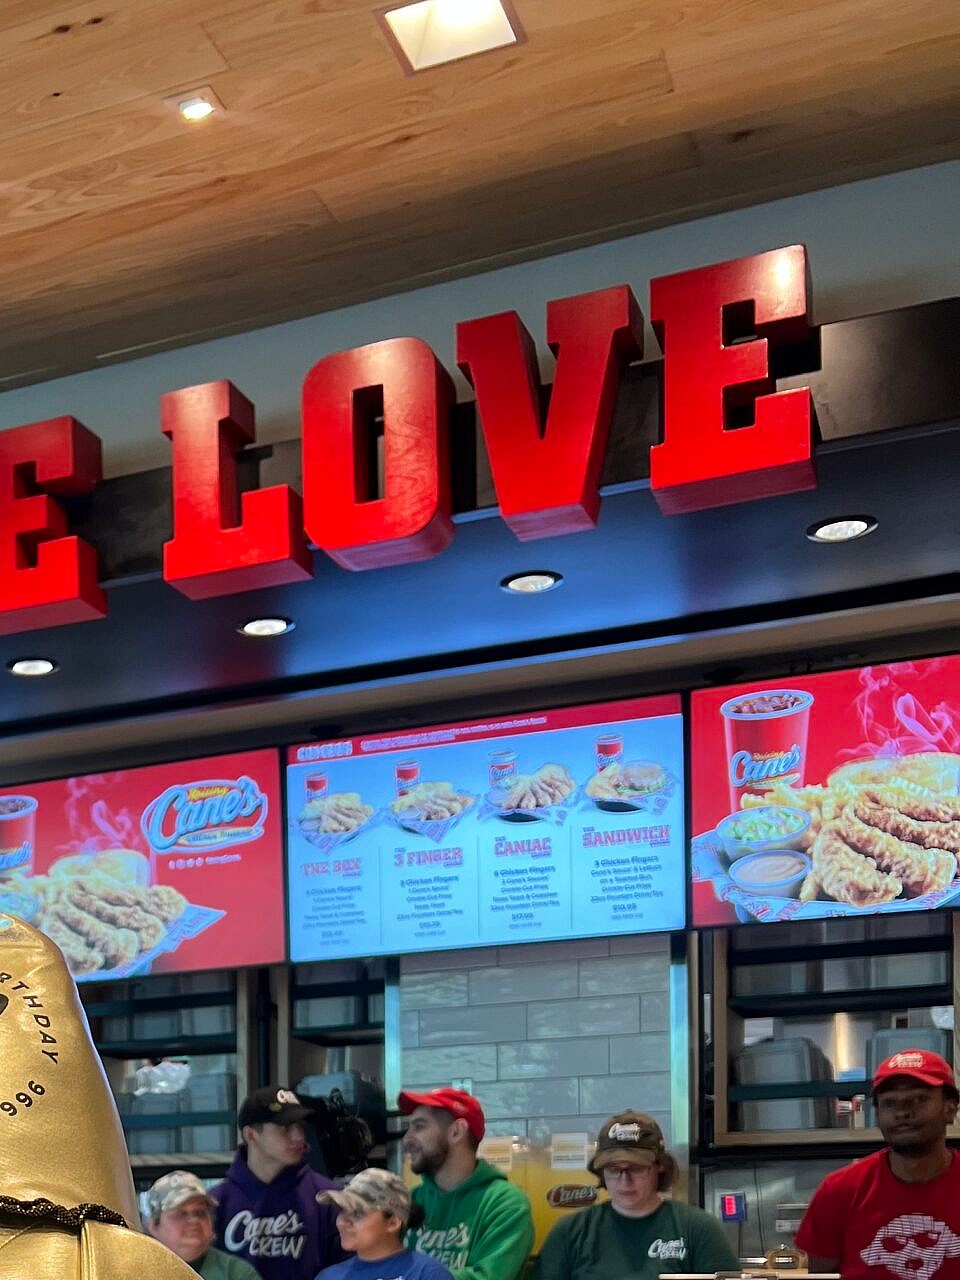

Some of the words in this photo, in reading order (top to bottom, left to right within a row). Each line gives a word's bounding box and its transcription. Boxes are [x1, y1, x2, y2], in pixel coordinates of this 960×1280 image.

[162, 244, 817, 597] LOVE
[148, 776, 263, 850] Cane's
[225, 1209, 304, 1252] Cane's
[249, 1235, 305, 1259] CREW
